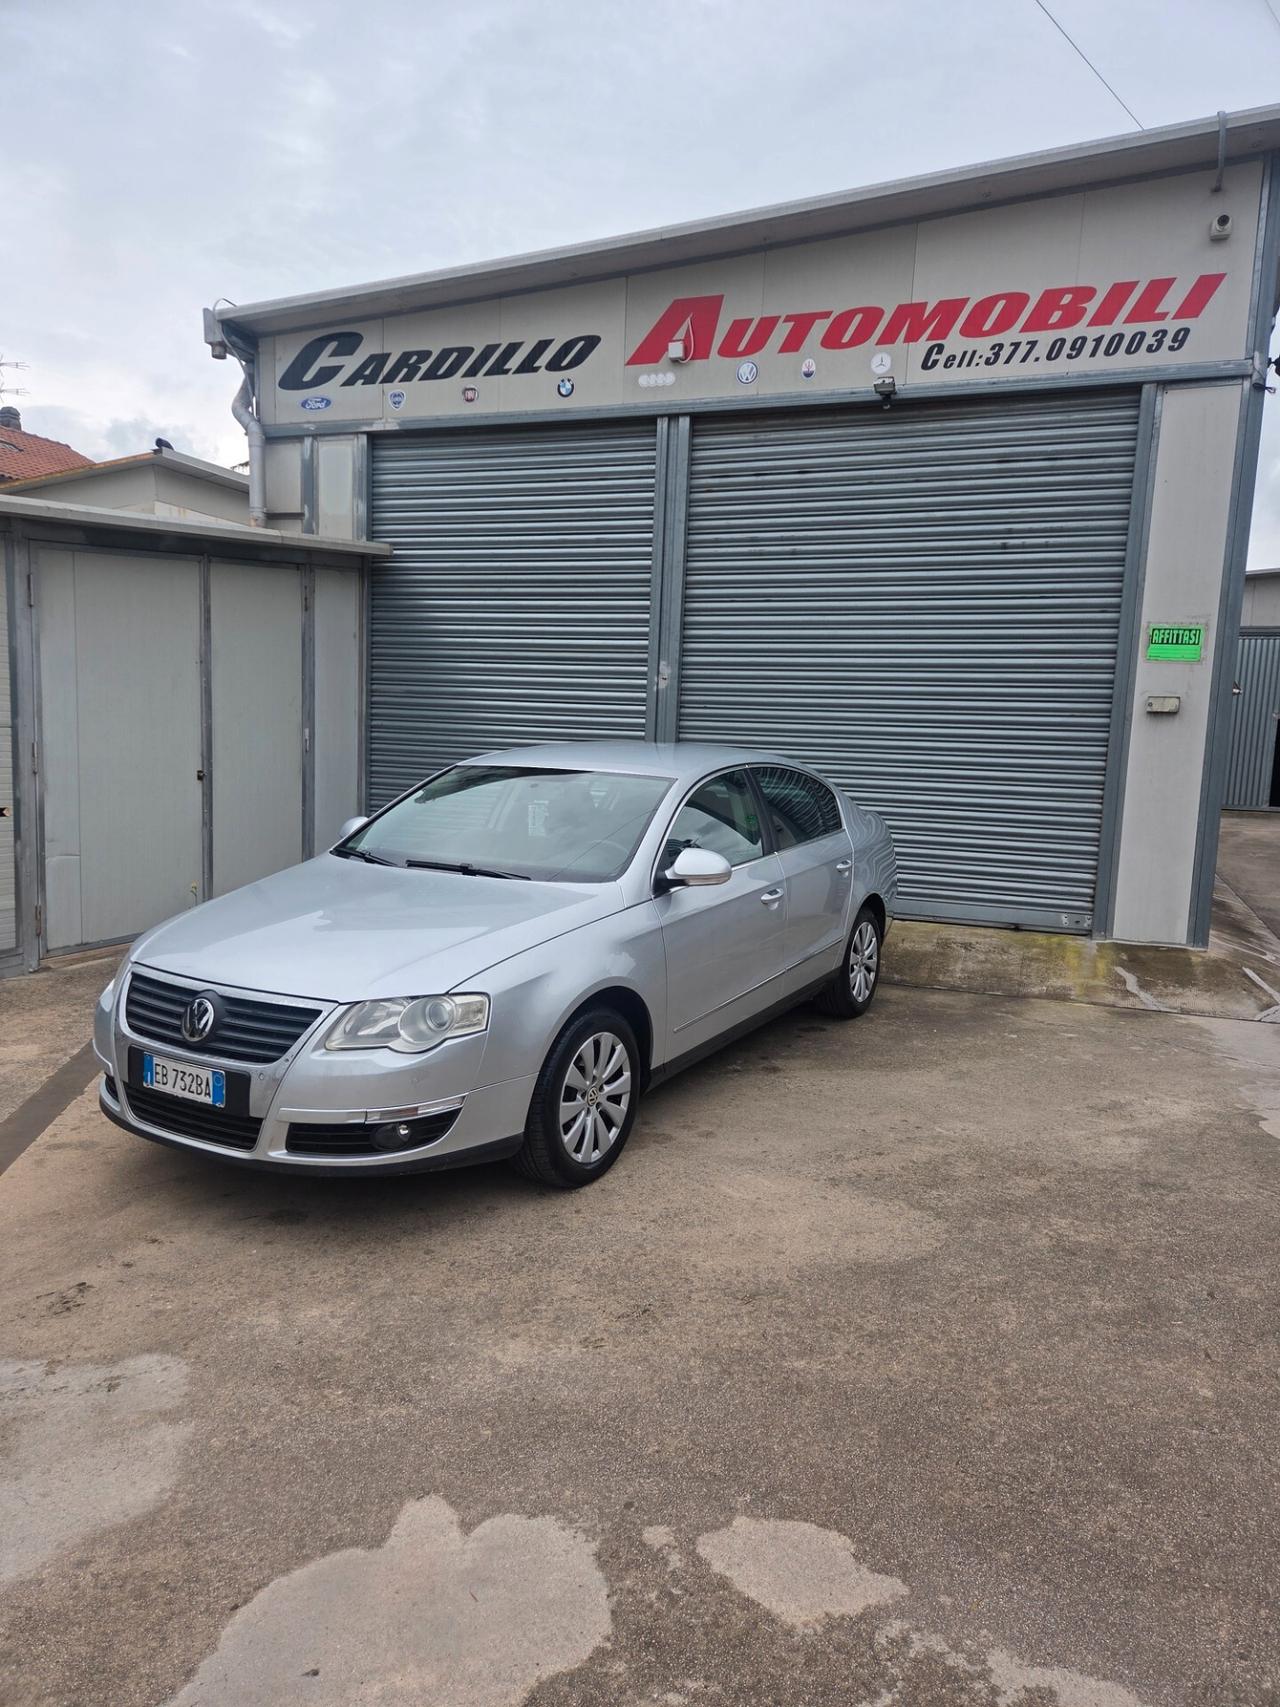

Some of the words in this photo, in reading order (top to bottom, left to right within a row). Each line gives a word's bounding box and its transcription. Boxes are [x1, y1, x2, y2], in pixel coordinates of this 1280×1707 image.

[278, 331, 601, 391] CARDILLO
[625, 273, 1228, 365] AUTOMOBILI
[1152, 629, 1200, 645] AFFITTASI
[154, 1063, 168, 1085] EB
[172, 1068, 212, 1099] 732BA
